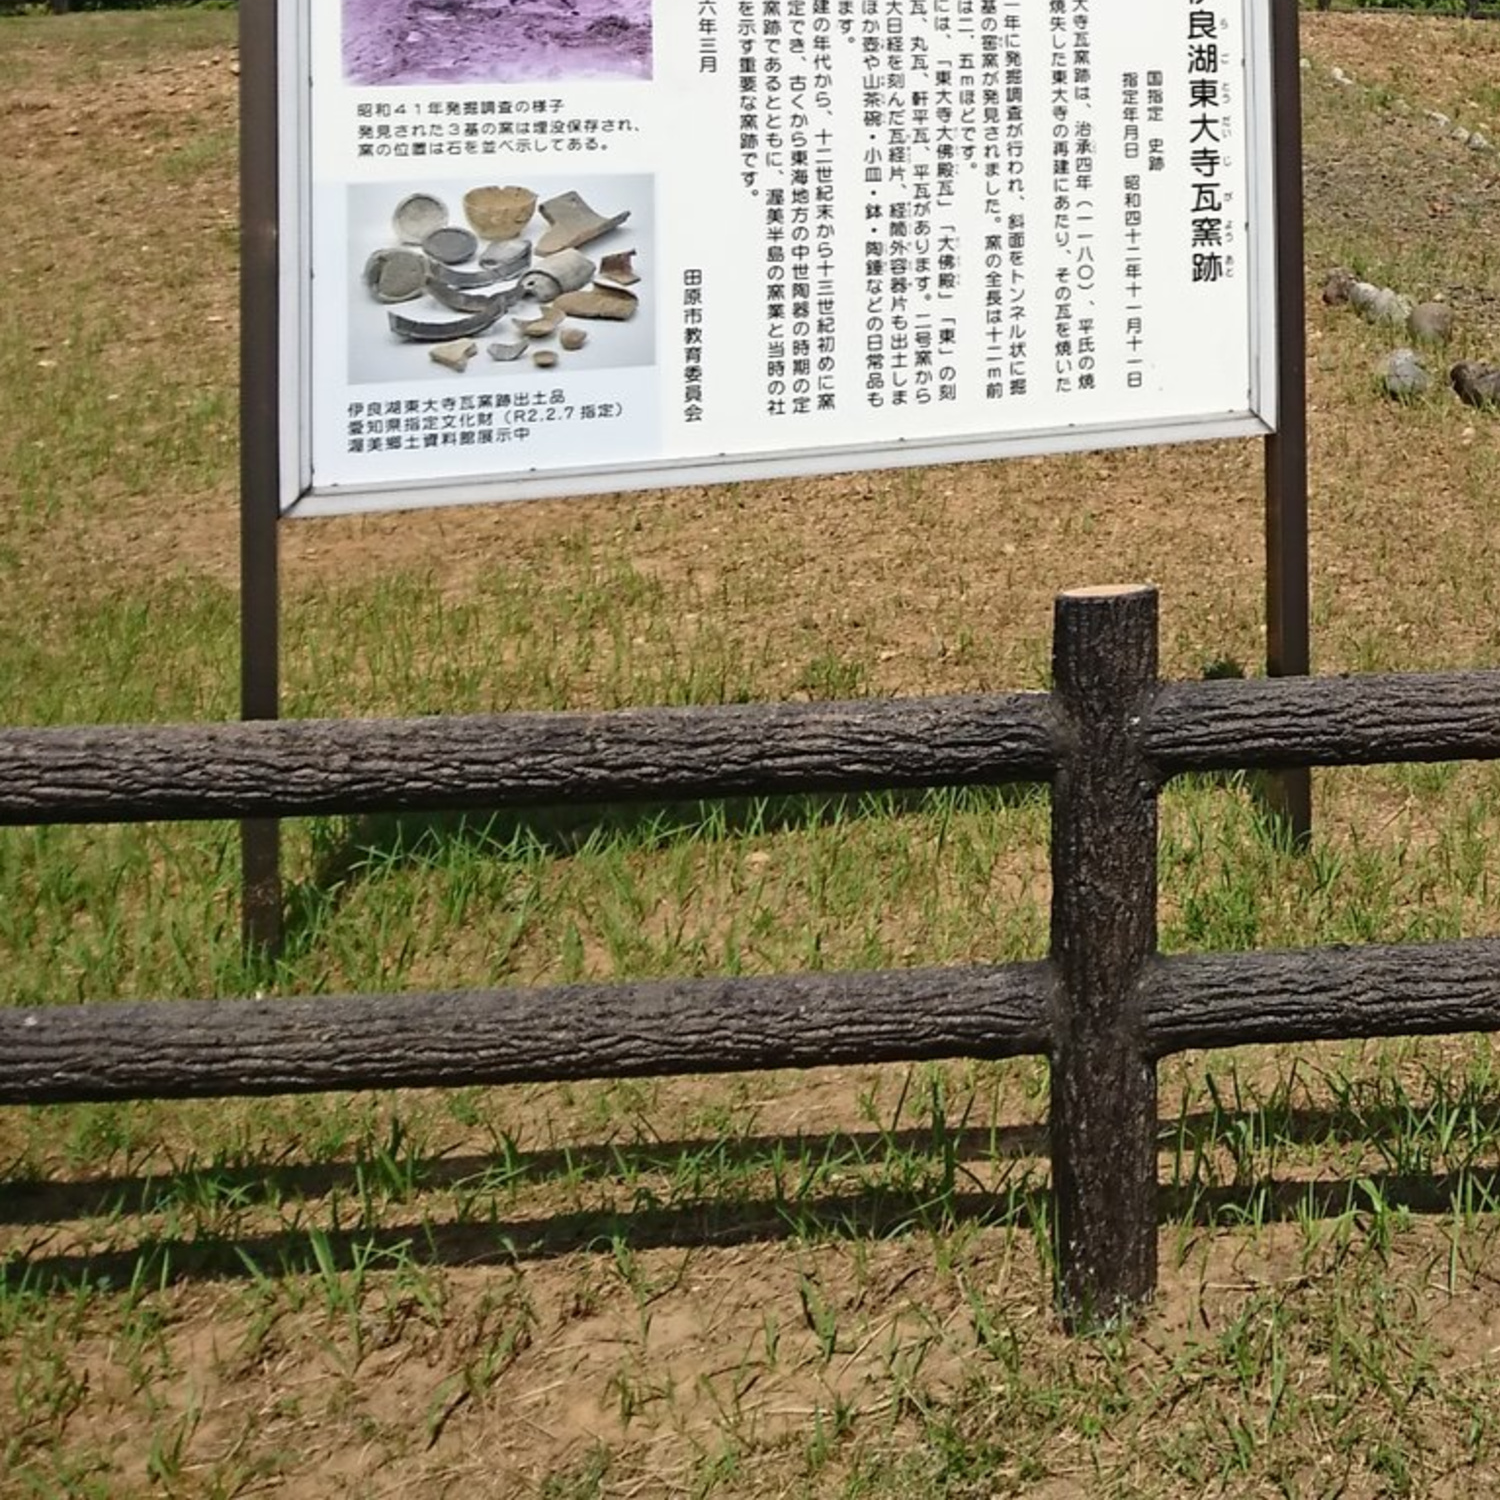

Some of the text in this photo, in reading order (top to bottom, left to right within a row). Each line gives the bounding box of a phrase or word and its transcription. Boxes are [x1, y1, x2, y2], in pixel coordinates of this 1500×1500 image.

[1146, 70, 1165, 171] 国指定 史跡
[1122, 72, 1143, 388] 指定年月日 昭和四十二年十一月十一日
[683, 269, 703, 422] 田原市教育委員会
[347, 389, 565, 418] 伊良湖東大寺瓦窯跡出土品
[347, 427, 530, 453] 渥美郷土資料館展示中
